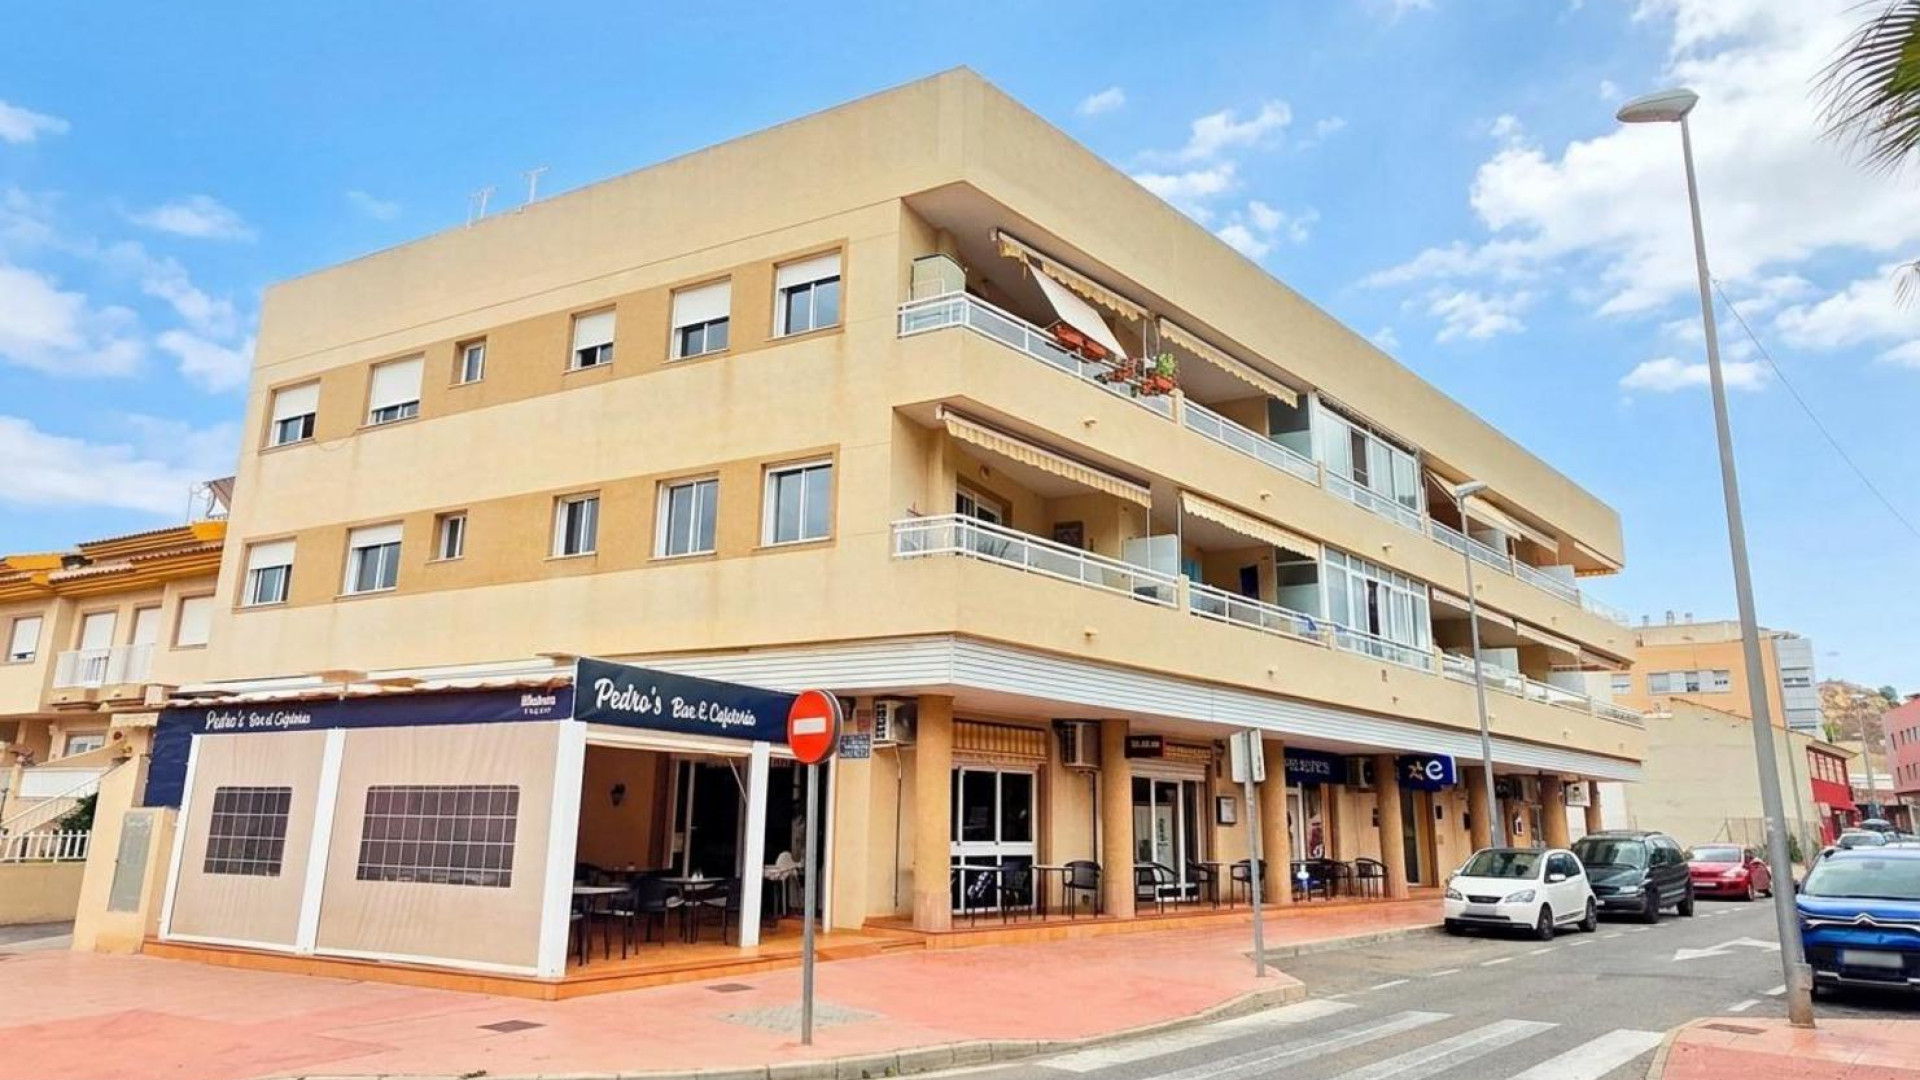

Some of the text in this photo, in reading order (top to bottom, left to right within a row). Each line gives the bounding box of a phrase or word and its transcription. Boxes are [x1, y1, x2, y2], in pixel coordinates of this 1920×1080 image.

[594, 677, 662, 715] Pedro's
[671, 696, 696, 719] Bar
[205, 709, 246, 731] Pedro's
